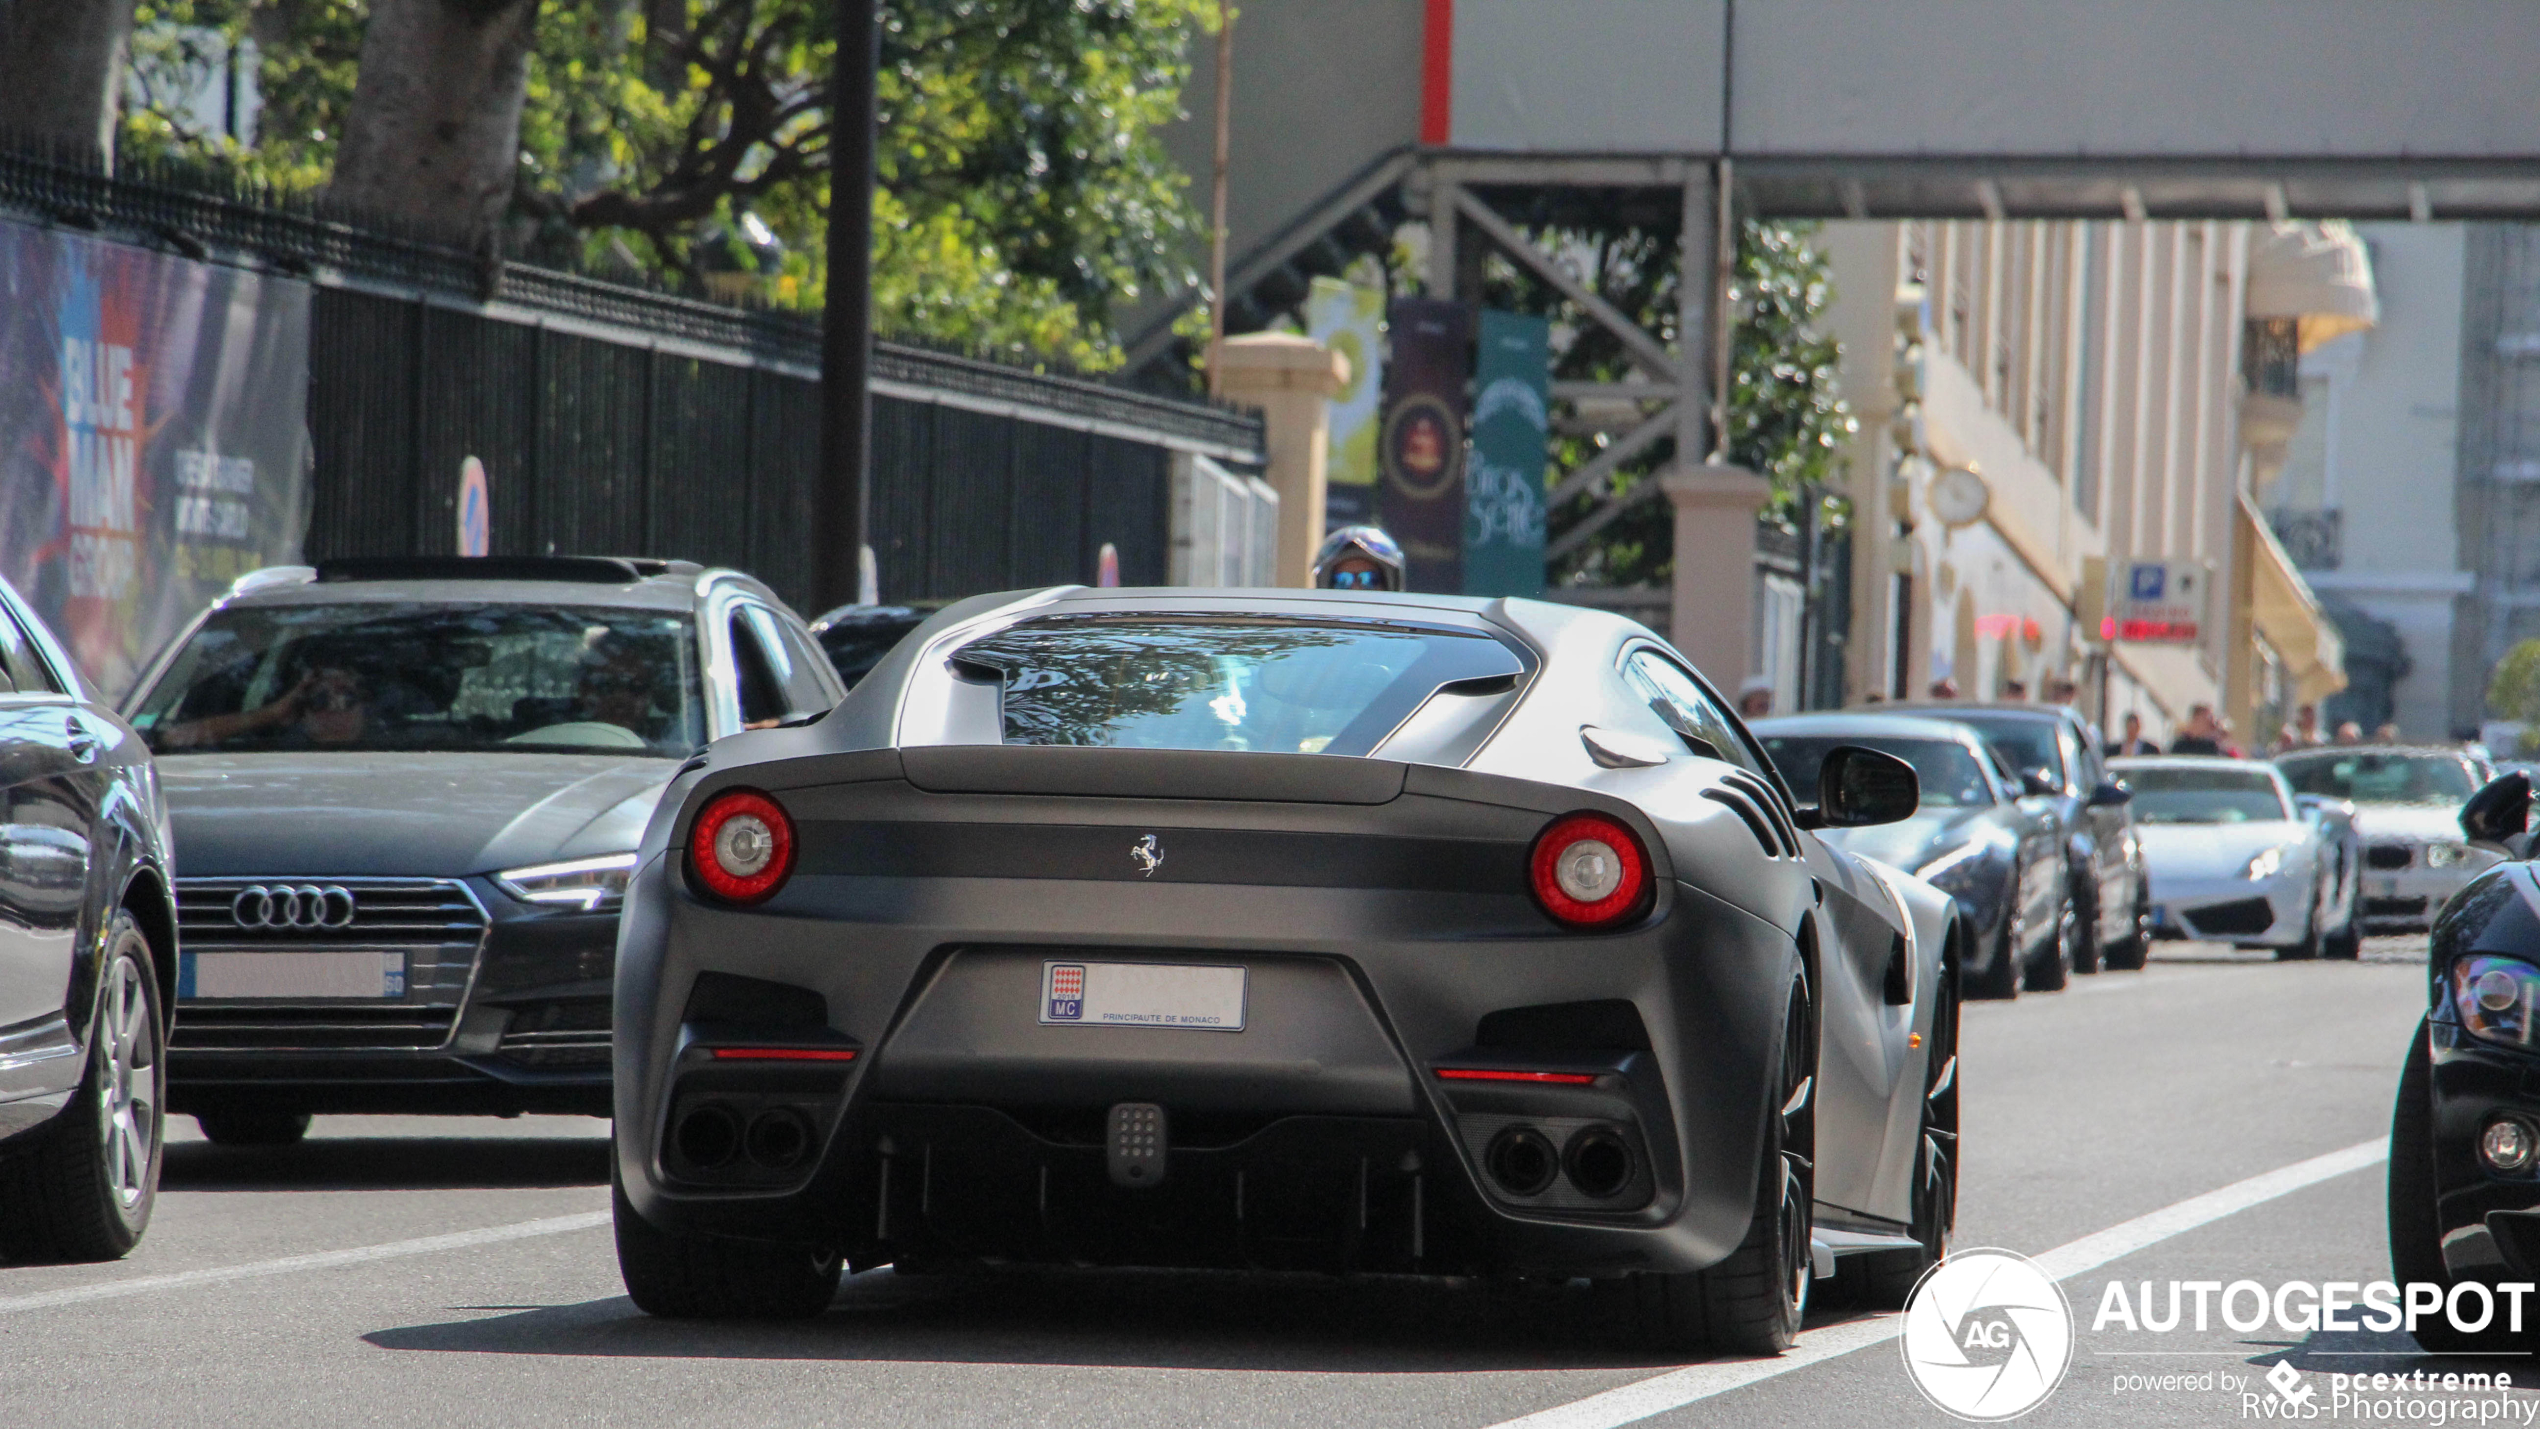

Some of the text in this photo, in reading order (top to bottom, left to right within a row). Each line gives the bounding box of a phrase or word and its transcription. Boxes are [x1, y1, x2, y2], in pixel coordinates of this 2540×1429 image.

[65, 336, 132, 430] BLUE
[68, 427, 134, 532] MAN
[71, 533, 134, 600] GROUP
[1055, 1001, 1076, 1015] MC
[1103, 1013, 1162, 1023] PRINCIPAUTE
[1181, 1016, 1221, 1024] MONACO
